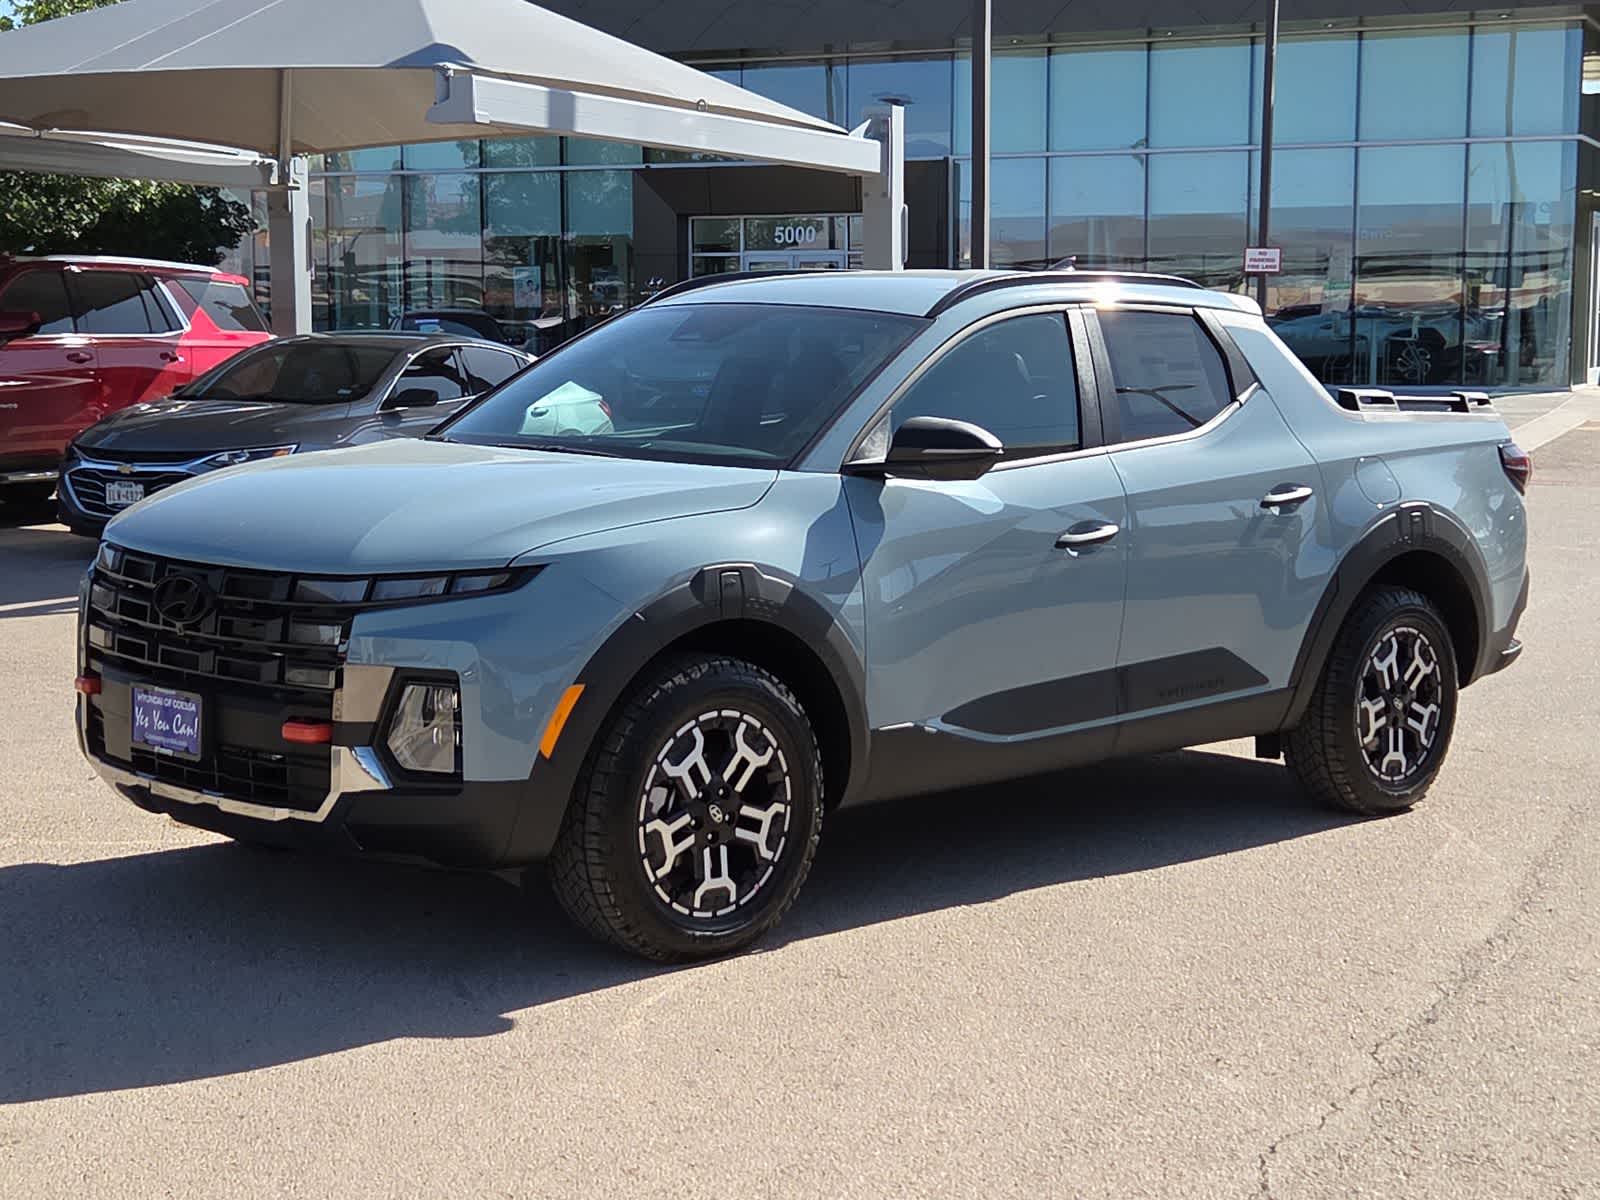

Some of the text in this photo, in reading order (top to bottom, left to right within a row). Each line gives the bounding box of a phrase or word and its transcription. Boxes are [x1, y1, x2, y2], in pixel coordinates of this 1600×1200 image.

[774, 225, 816, 244] 5000
[135, 706, 198, 738] Yes You Can!
